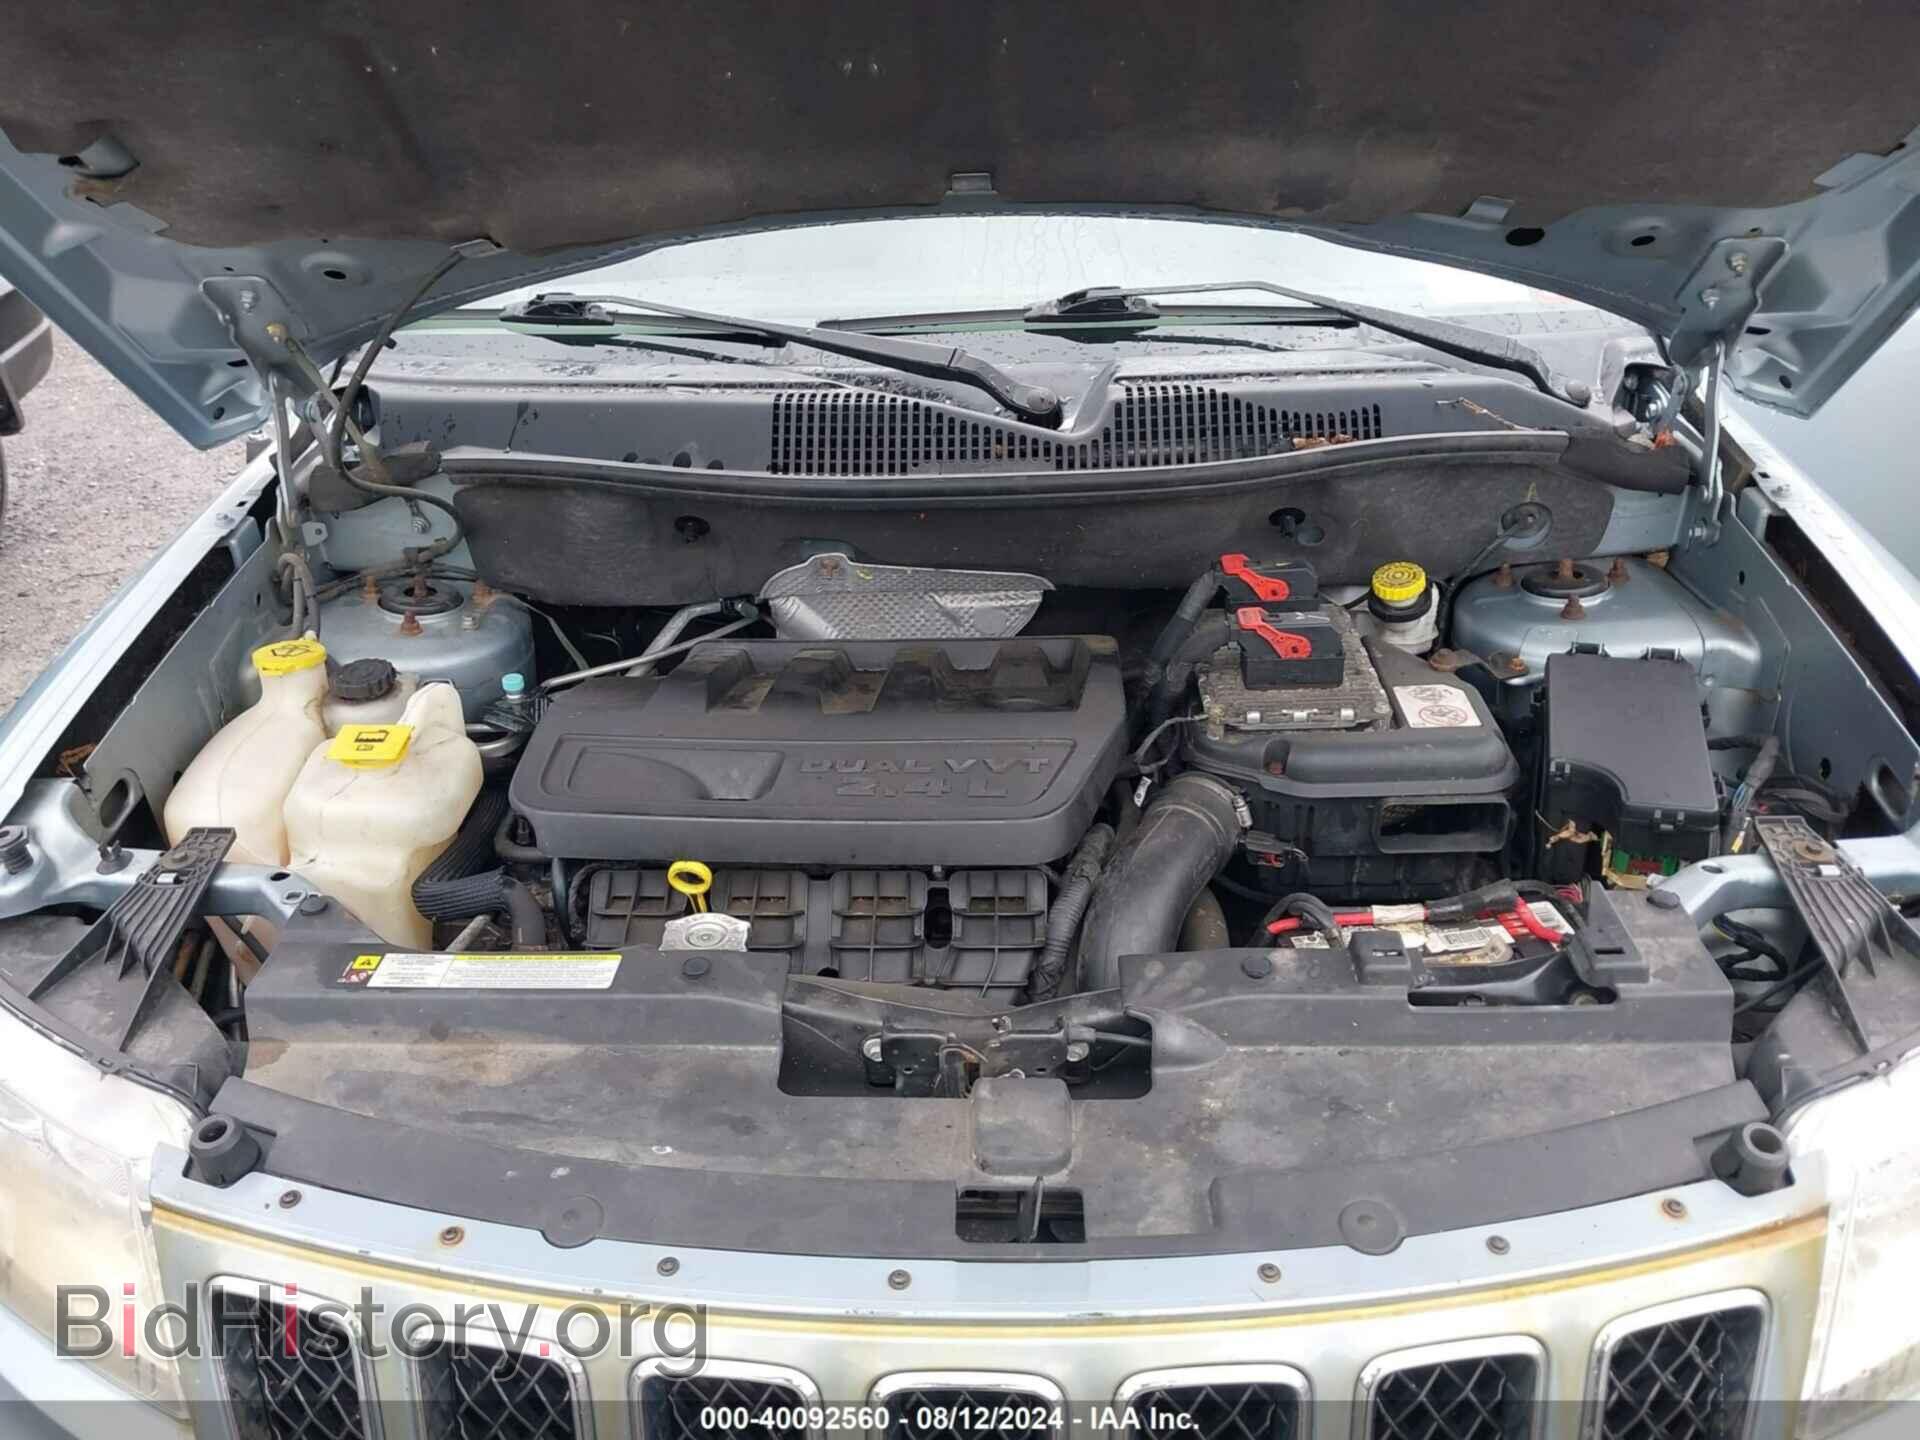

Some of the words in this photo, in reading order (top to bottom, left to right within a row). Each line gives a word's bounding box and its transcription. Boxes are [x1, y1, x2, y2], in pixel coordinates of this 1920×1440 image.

[799, 758, 934, 775] DUAL
[944, 758, 1050, 775] VVT
[834, 776, 1009, 798] 2.4L
